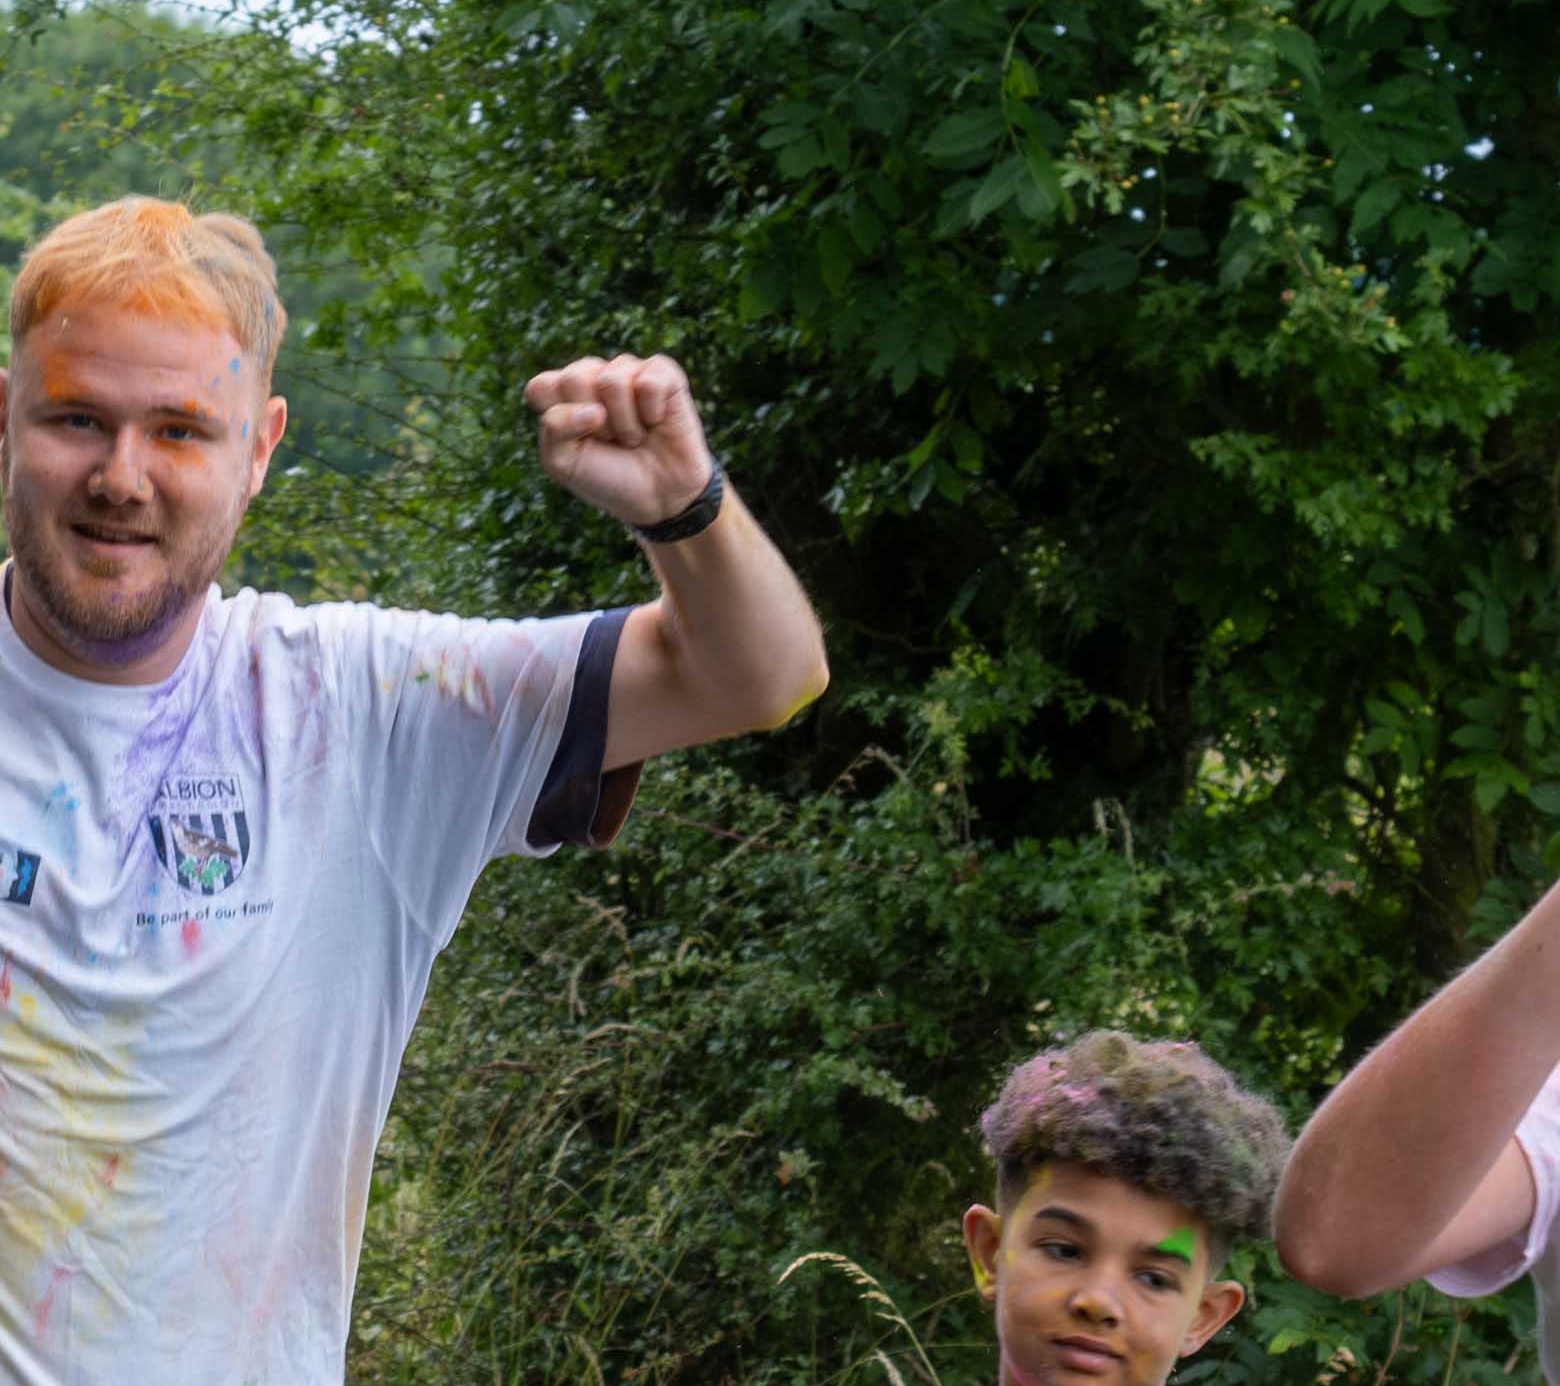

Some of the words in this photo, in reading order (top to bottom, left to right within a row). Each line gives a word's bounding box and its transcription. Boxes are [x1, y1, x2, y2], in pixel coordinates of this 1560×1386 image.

[136, 913, 156, 927] Be
[161, 909, 189, 927] part
[195, 906, 211, 921] of
[215, 907, 237, 920] our
